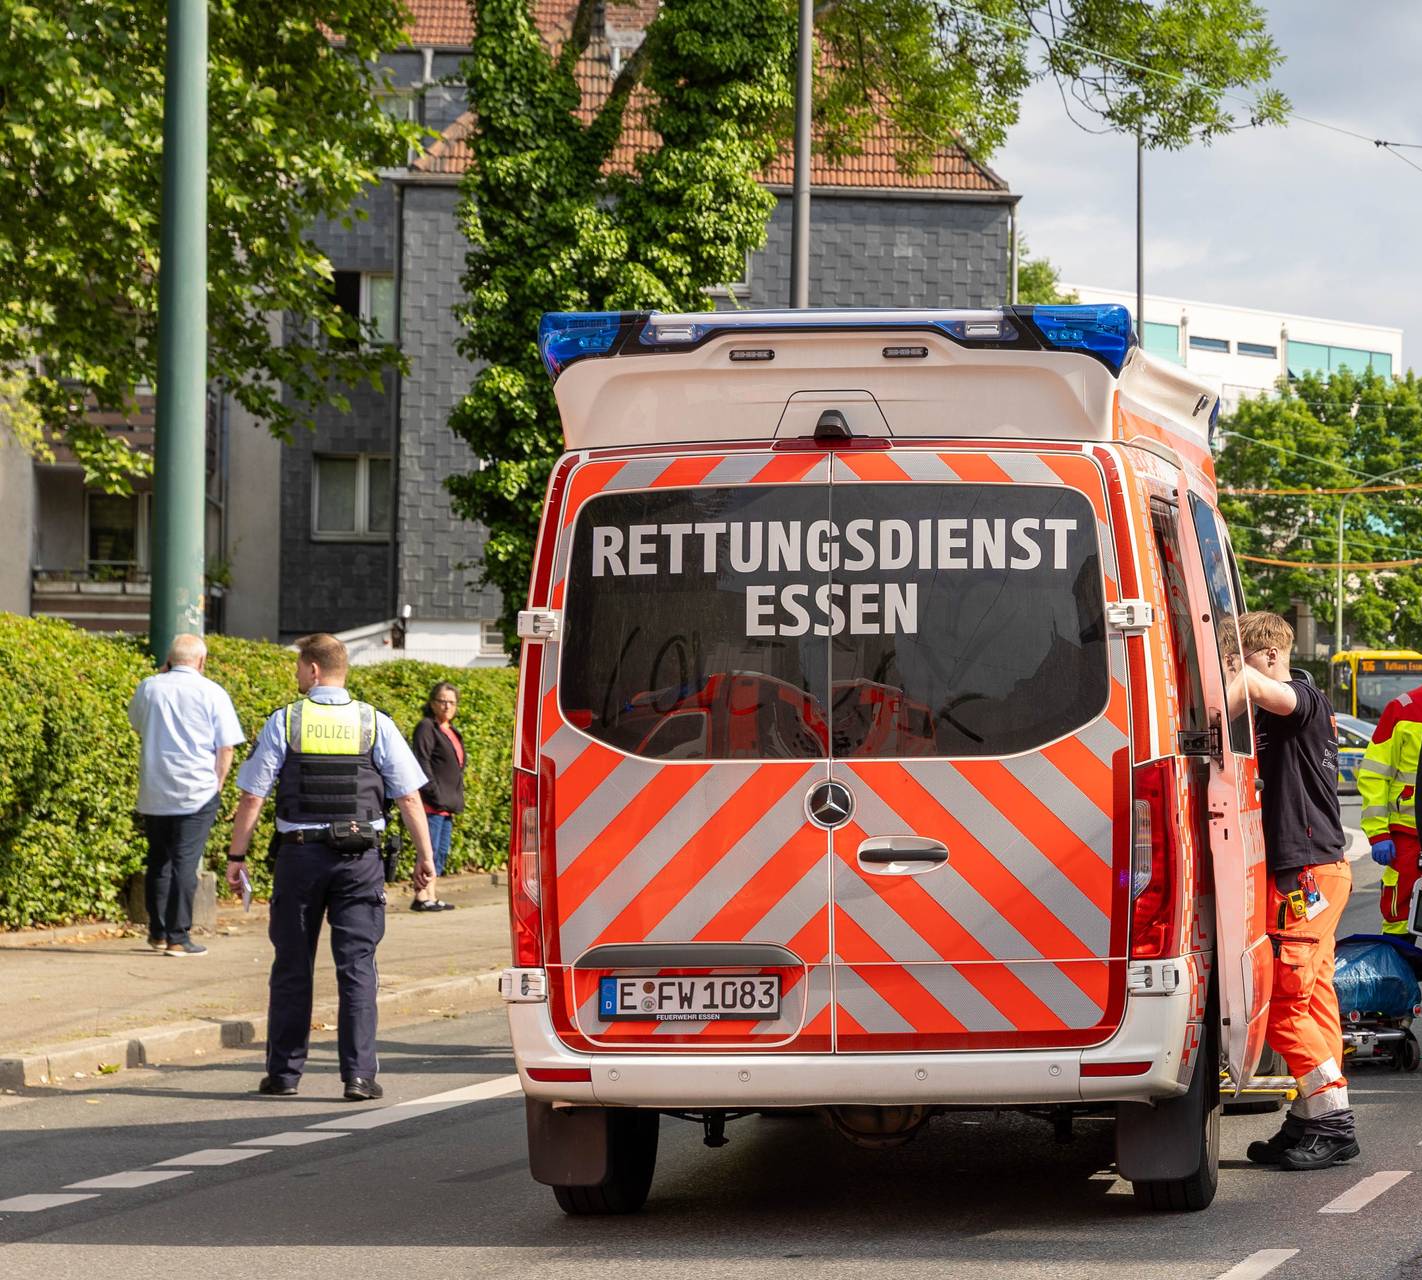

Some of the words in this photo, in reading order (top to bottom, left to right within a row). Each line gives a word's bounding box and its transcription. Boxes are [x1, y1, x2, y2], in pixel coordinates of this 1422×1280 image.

[592, 519, 1077, 577] RETTUNGSDIENST
[745, 583, 919, 637] ESSEN
[306, 724, 354, 740] POLIZEI
[620, 982, 637, 1010] E
[658, 981, 695, 1010] FW
[702, 980, 775, 1009] 1083
[656, 1013, 698, 1021] FEUERWEHR
